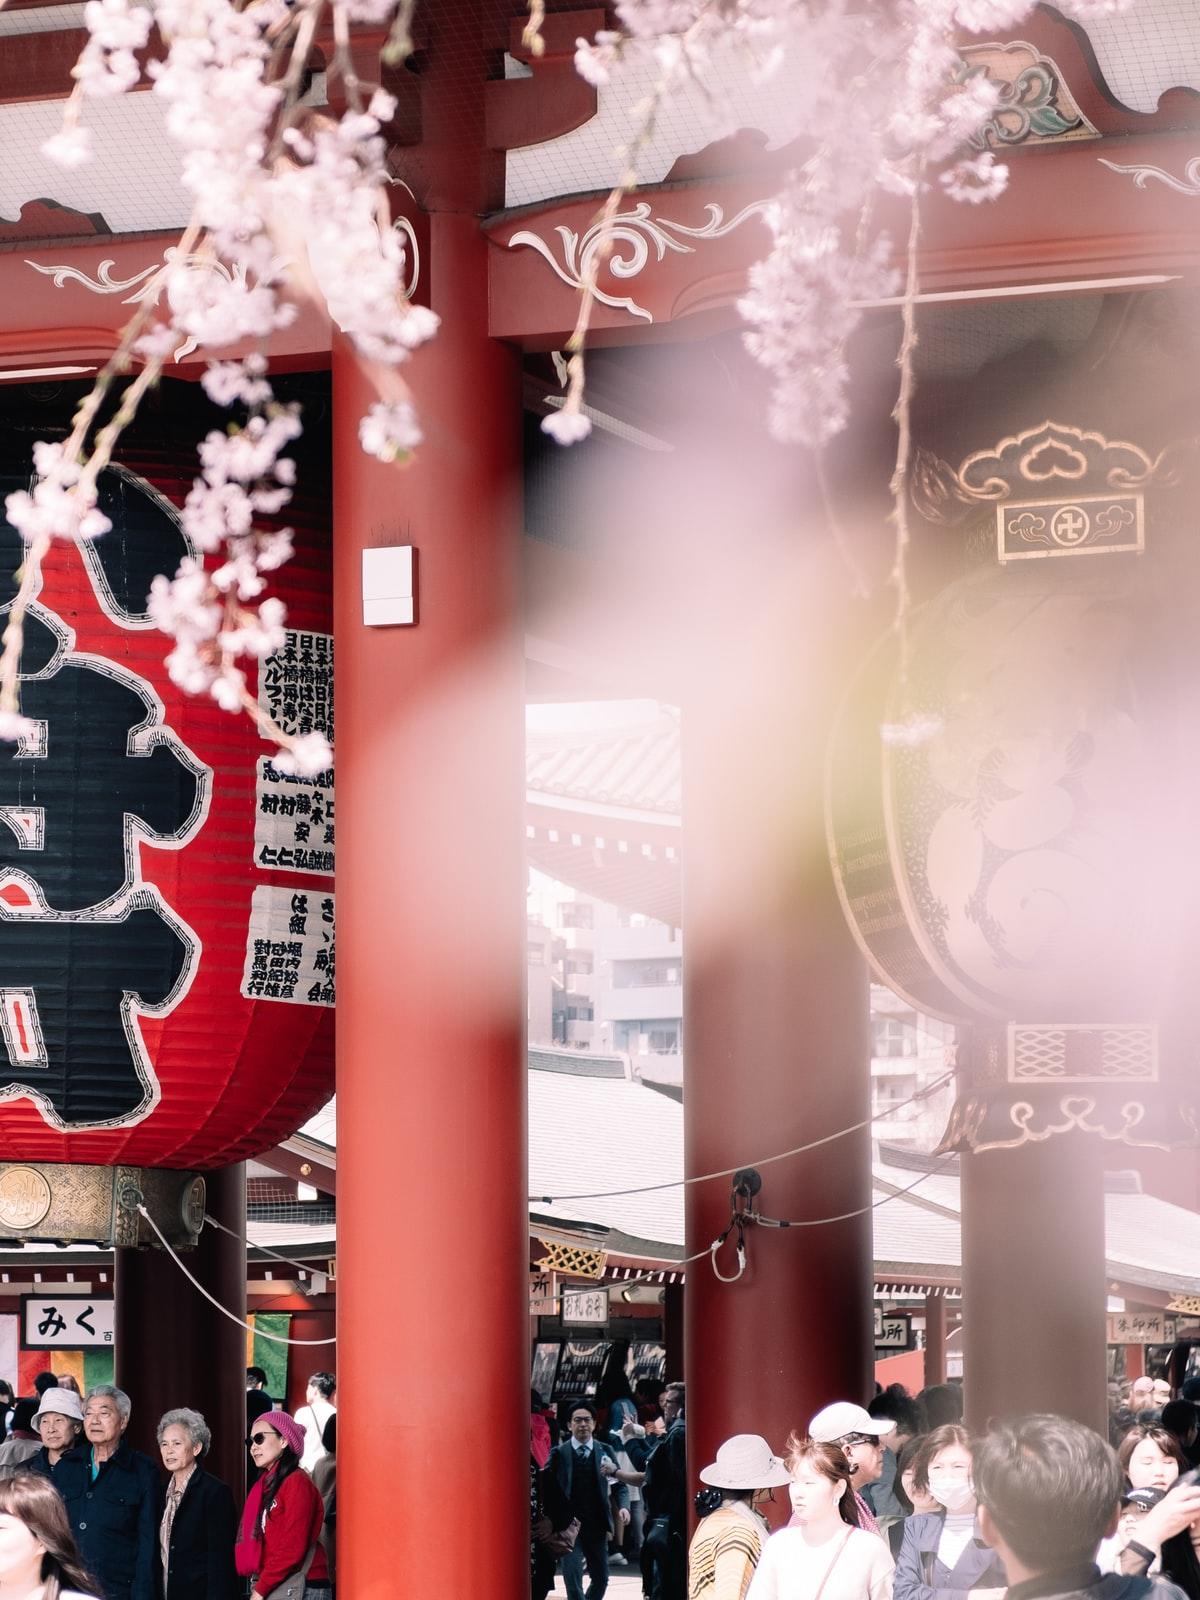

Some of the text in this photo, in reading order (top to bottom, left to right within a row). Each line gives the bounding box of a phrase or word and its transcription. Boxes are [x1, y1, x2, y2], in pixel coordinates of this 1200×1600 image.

[294, 777, 312, 868] 藤安弘
[532, 1273, 550, 1297] 所
[38, 1306, 96, 1337] みく
